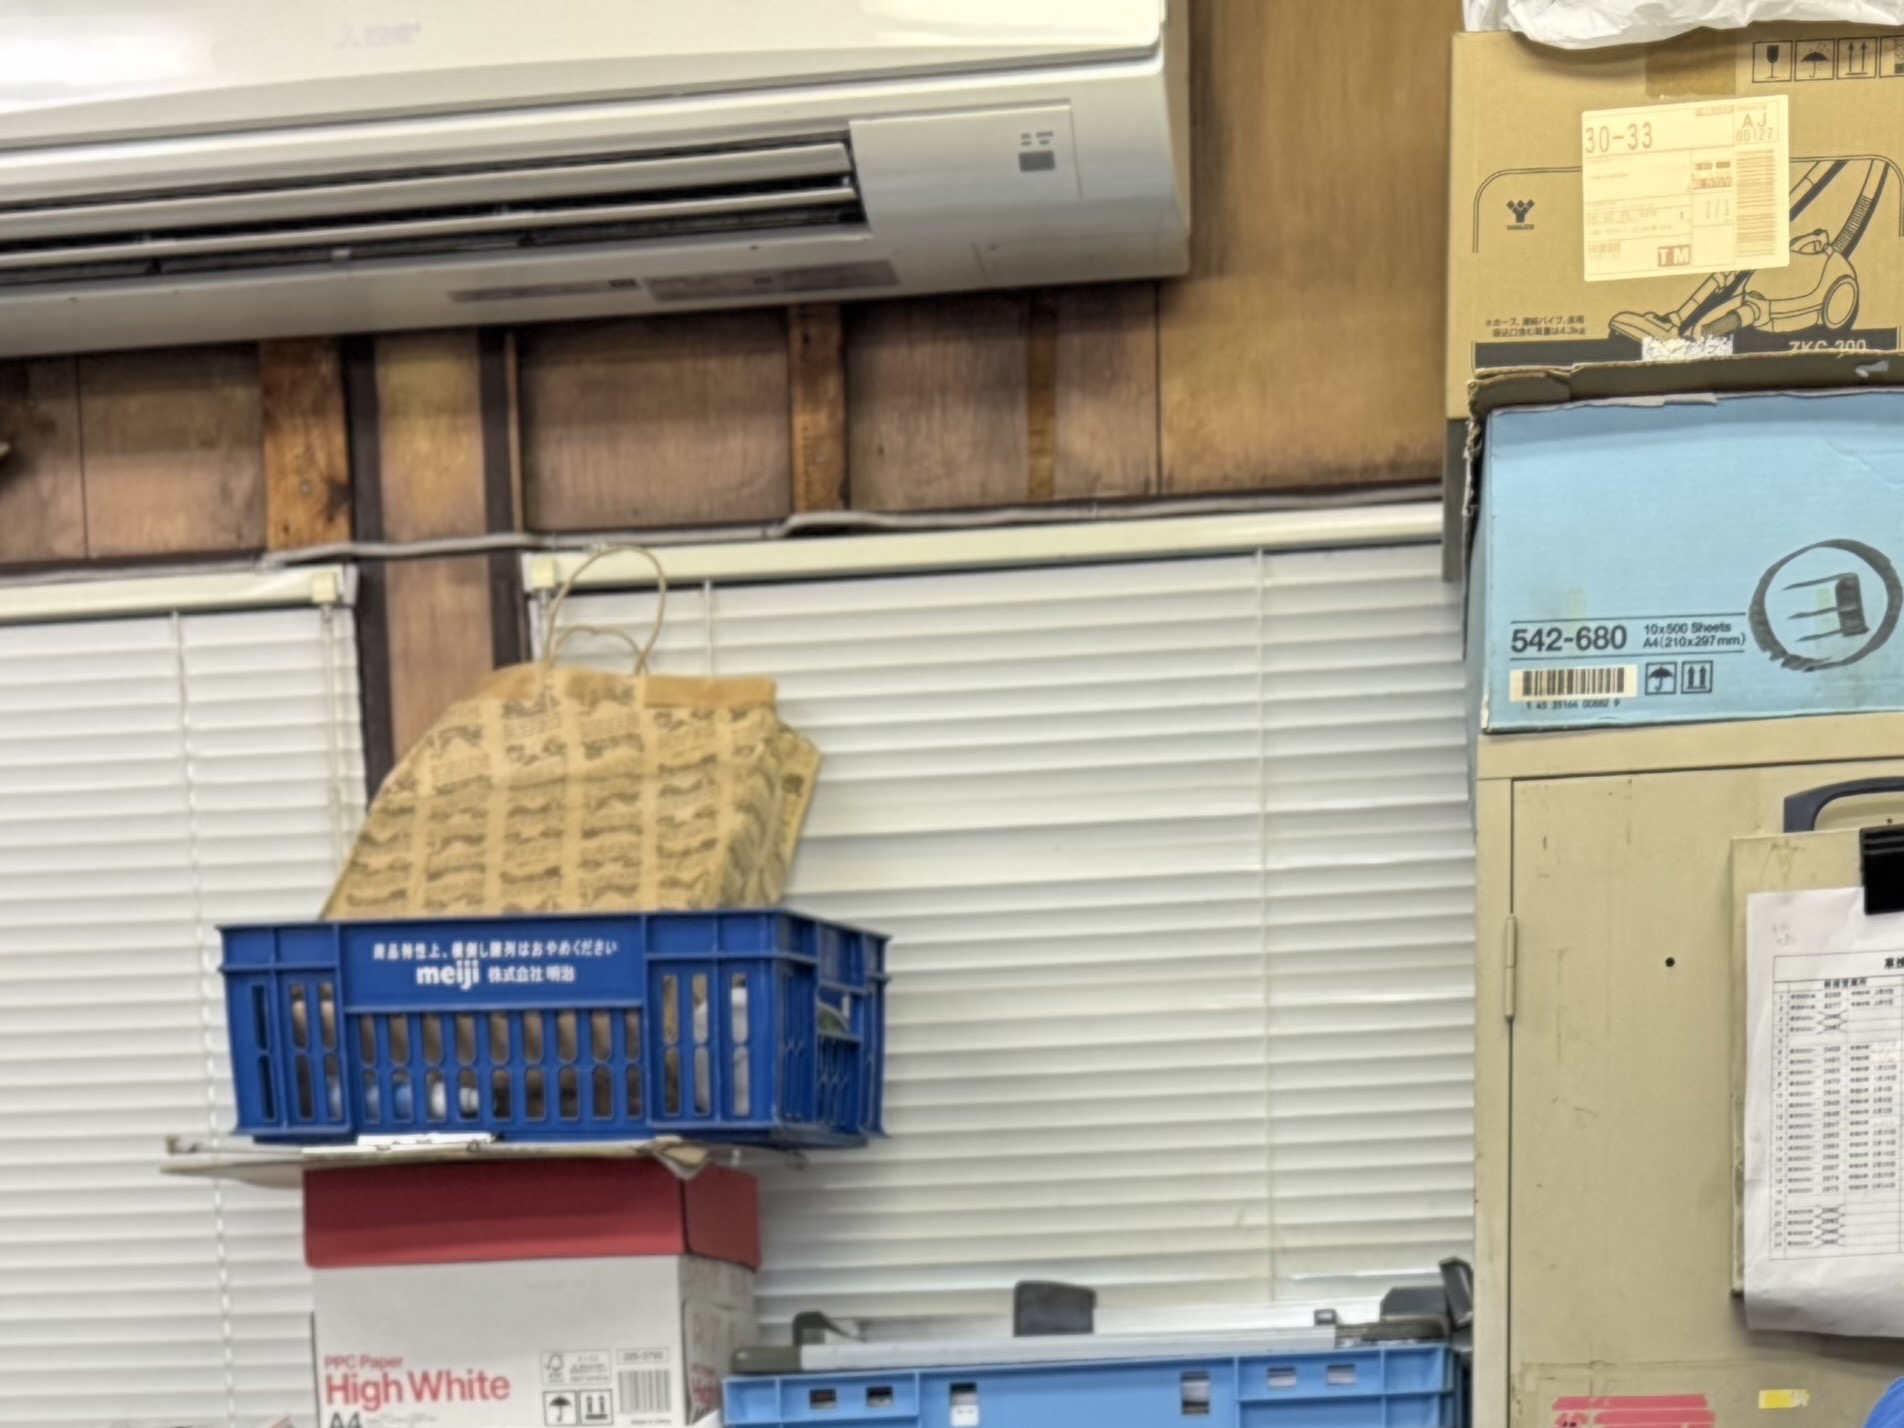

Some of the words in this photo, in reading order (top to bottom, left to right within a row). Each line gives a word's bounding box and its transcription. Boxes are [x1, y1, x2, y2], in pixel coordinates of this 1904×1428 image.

[1585, 121, 1653, 154] 30-33
[1511, 624, 1628, 654] 542-680
[416, 960, 480, 990] meiji
[488, 965, 543, 983] 株式会社
[546, 965, 576, 983] 明治
[359, 1354, 404, 1373] Paper
[324, 1371, 404, 1412] High
[408, 1369, 512, 1403] White
